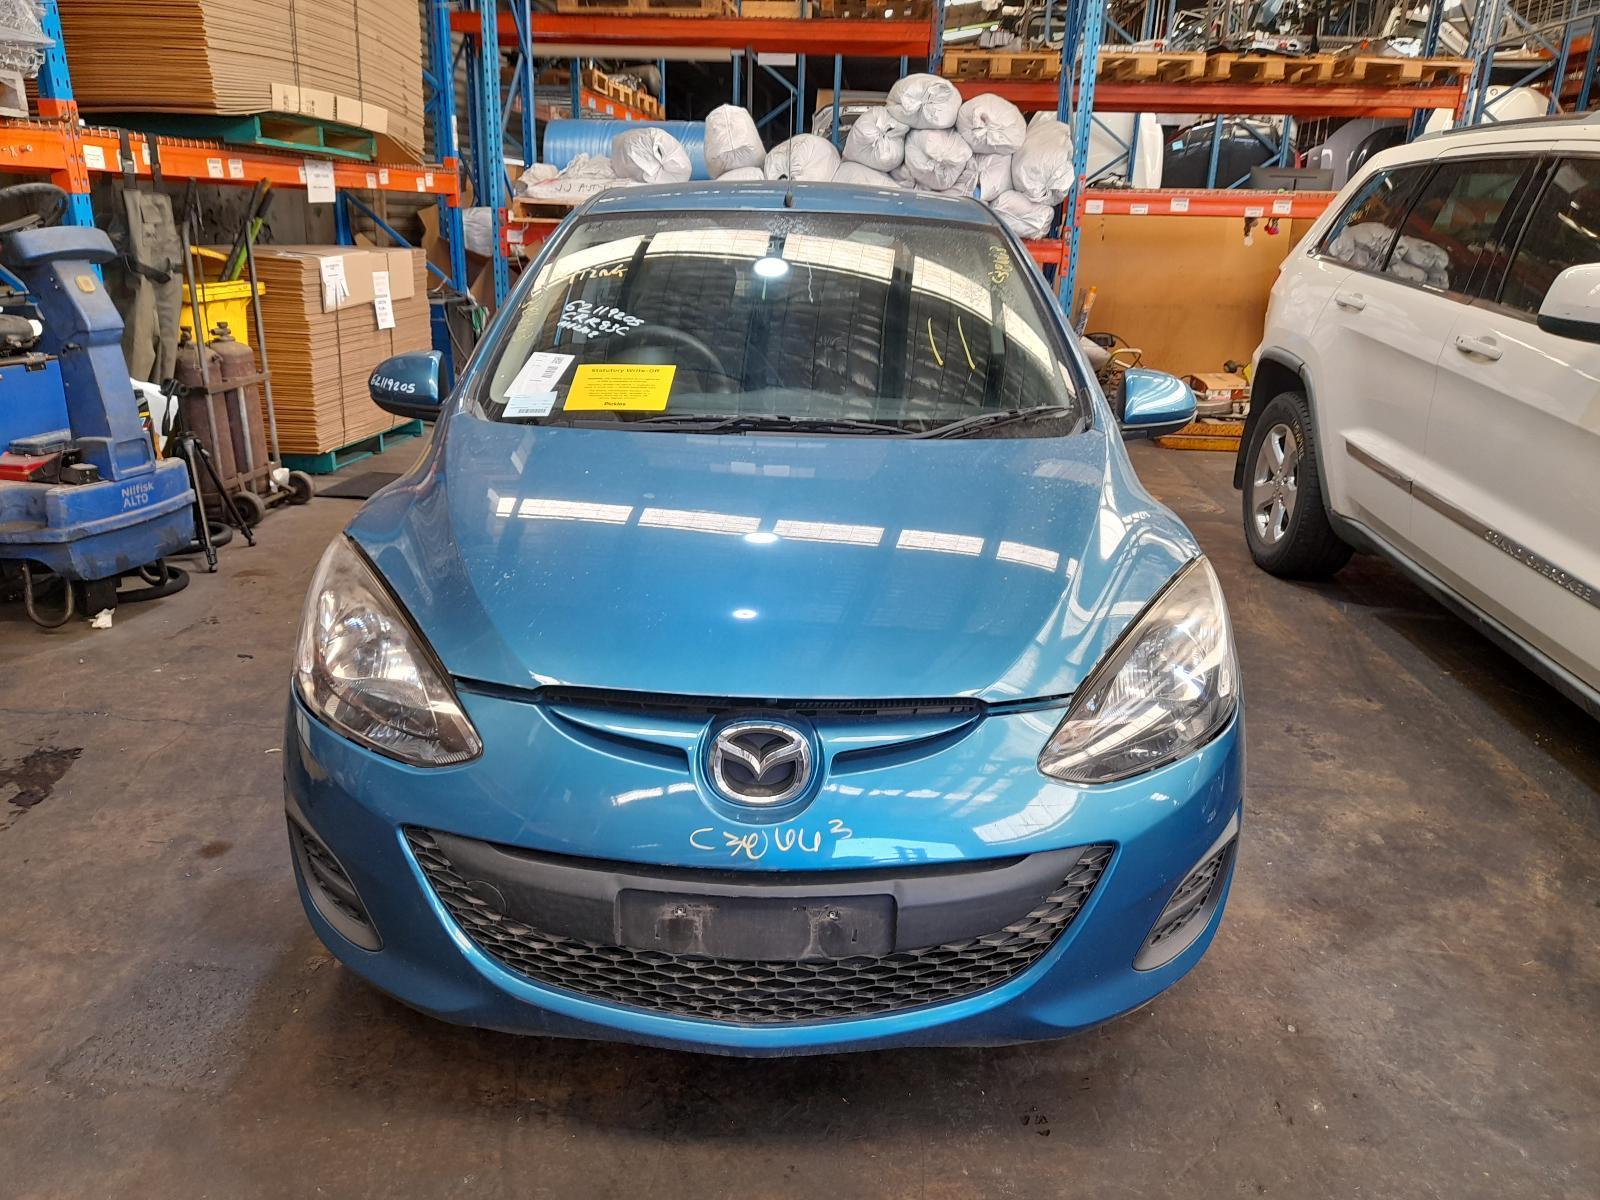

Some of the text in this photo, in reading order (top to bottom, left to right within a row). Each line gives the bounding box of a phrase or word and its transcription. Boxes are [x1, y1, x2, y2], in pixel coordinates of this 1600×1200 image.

[370, 374, 416, 393] 62119205
[121, 481, 155, 498] Nilfisk
[123, 493, 149, 509] ALTO
[1485, 529, 1593, 601] GRAND CHEROKEE
